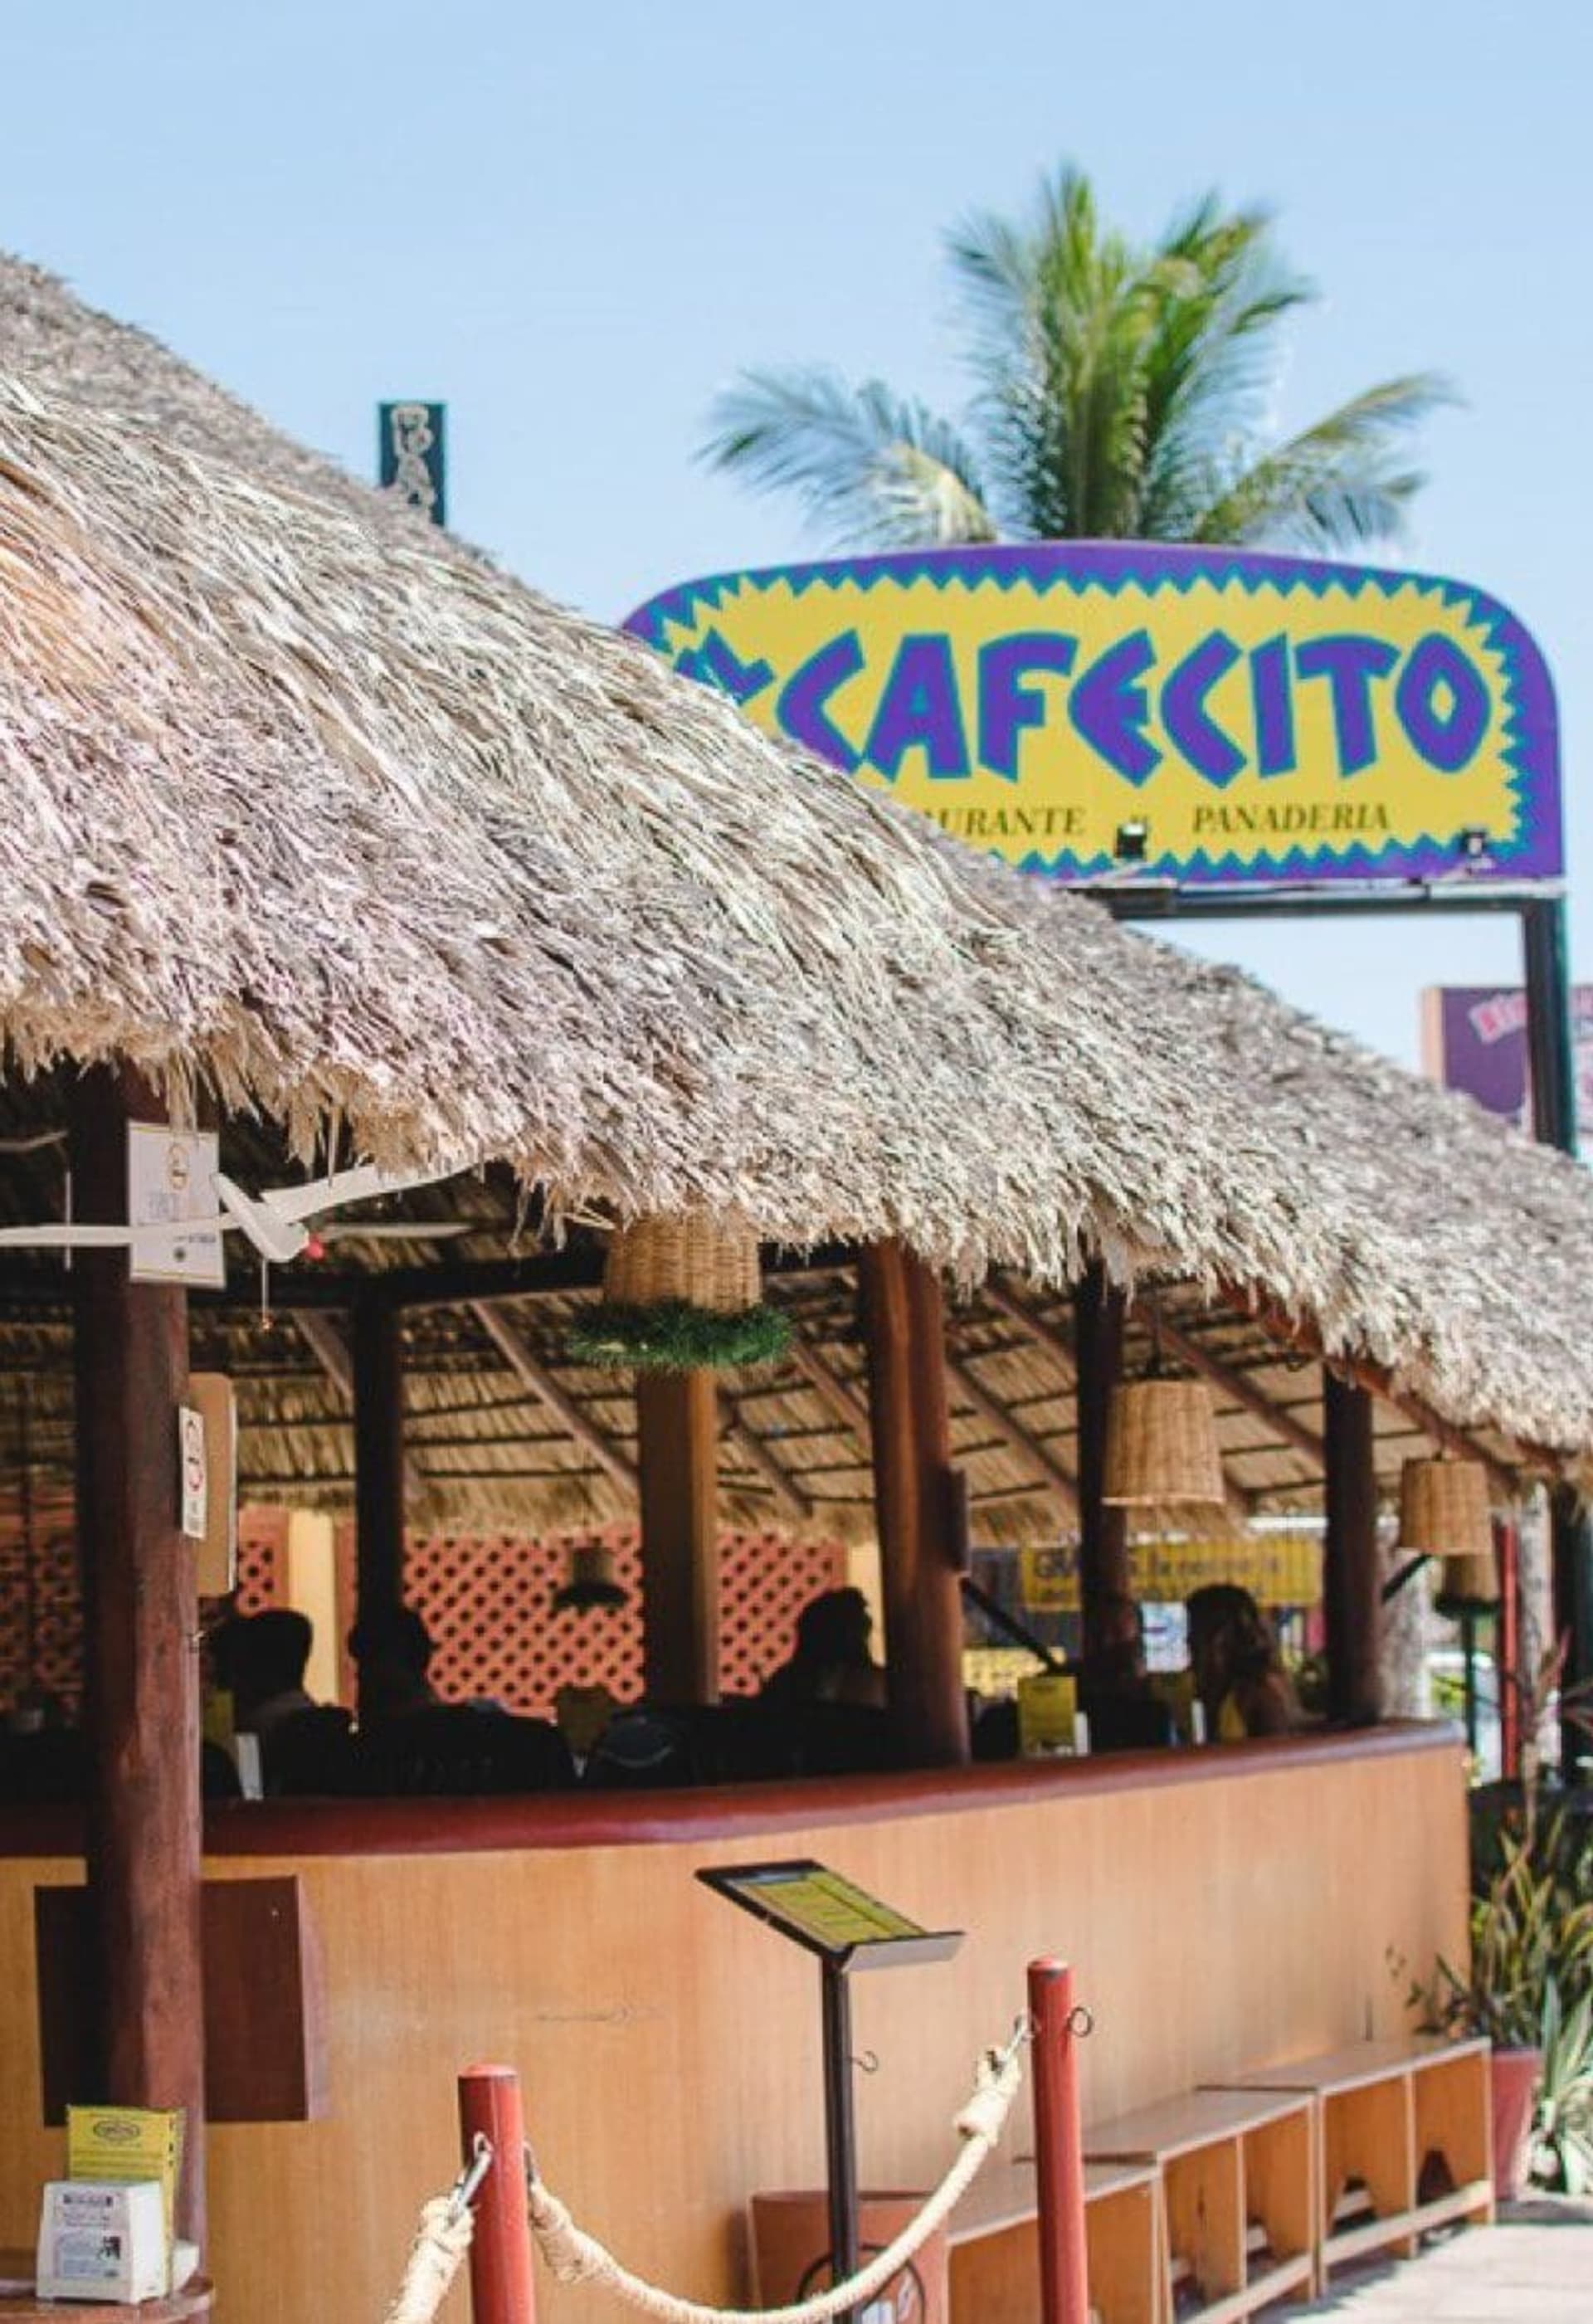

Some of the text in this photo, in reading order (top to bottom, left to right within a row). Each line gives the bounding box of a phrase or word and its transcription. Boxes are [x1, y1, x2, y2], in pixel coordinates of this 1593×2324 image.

[777, 628, 1492, 789] CAFECITO
[923, 802, 1391, 836] URANTE PANADERIA
